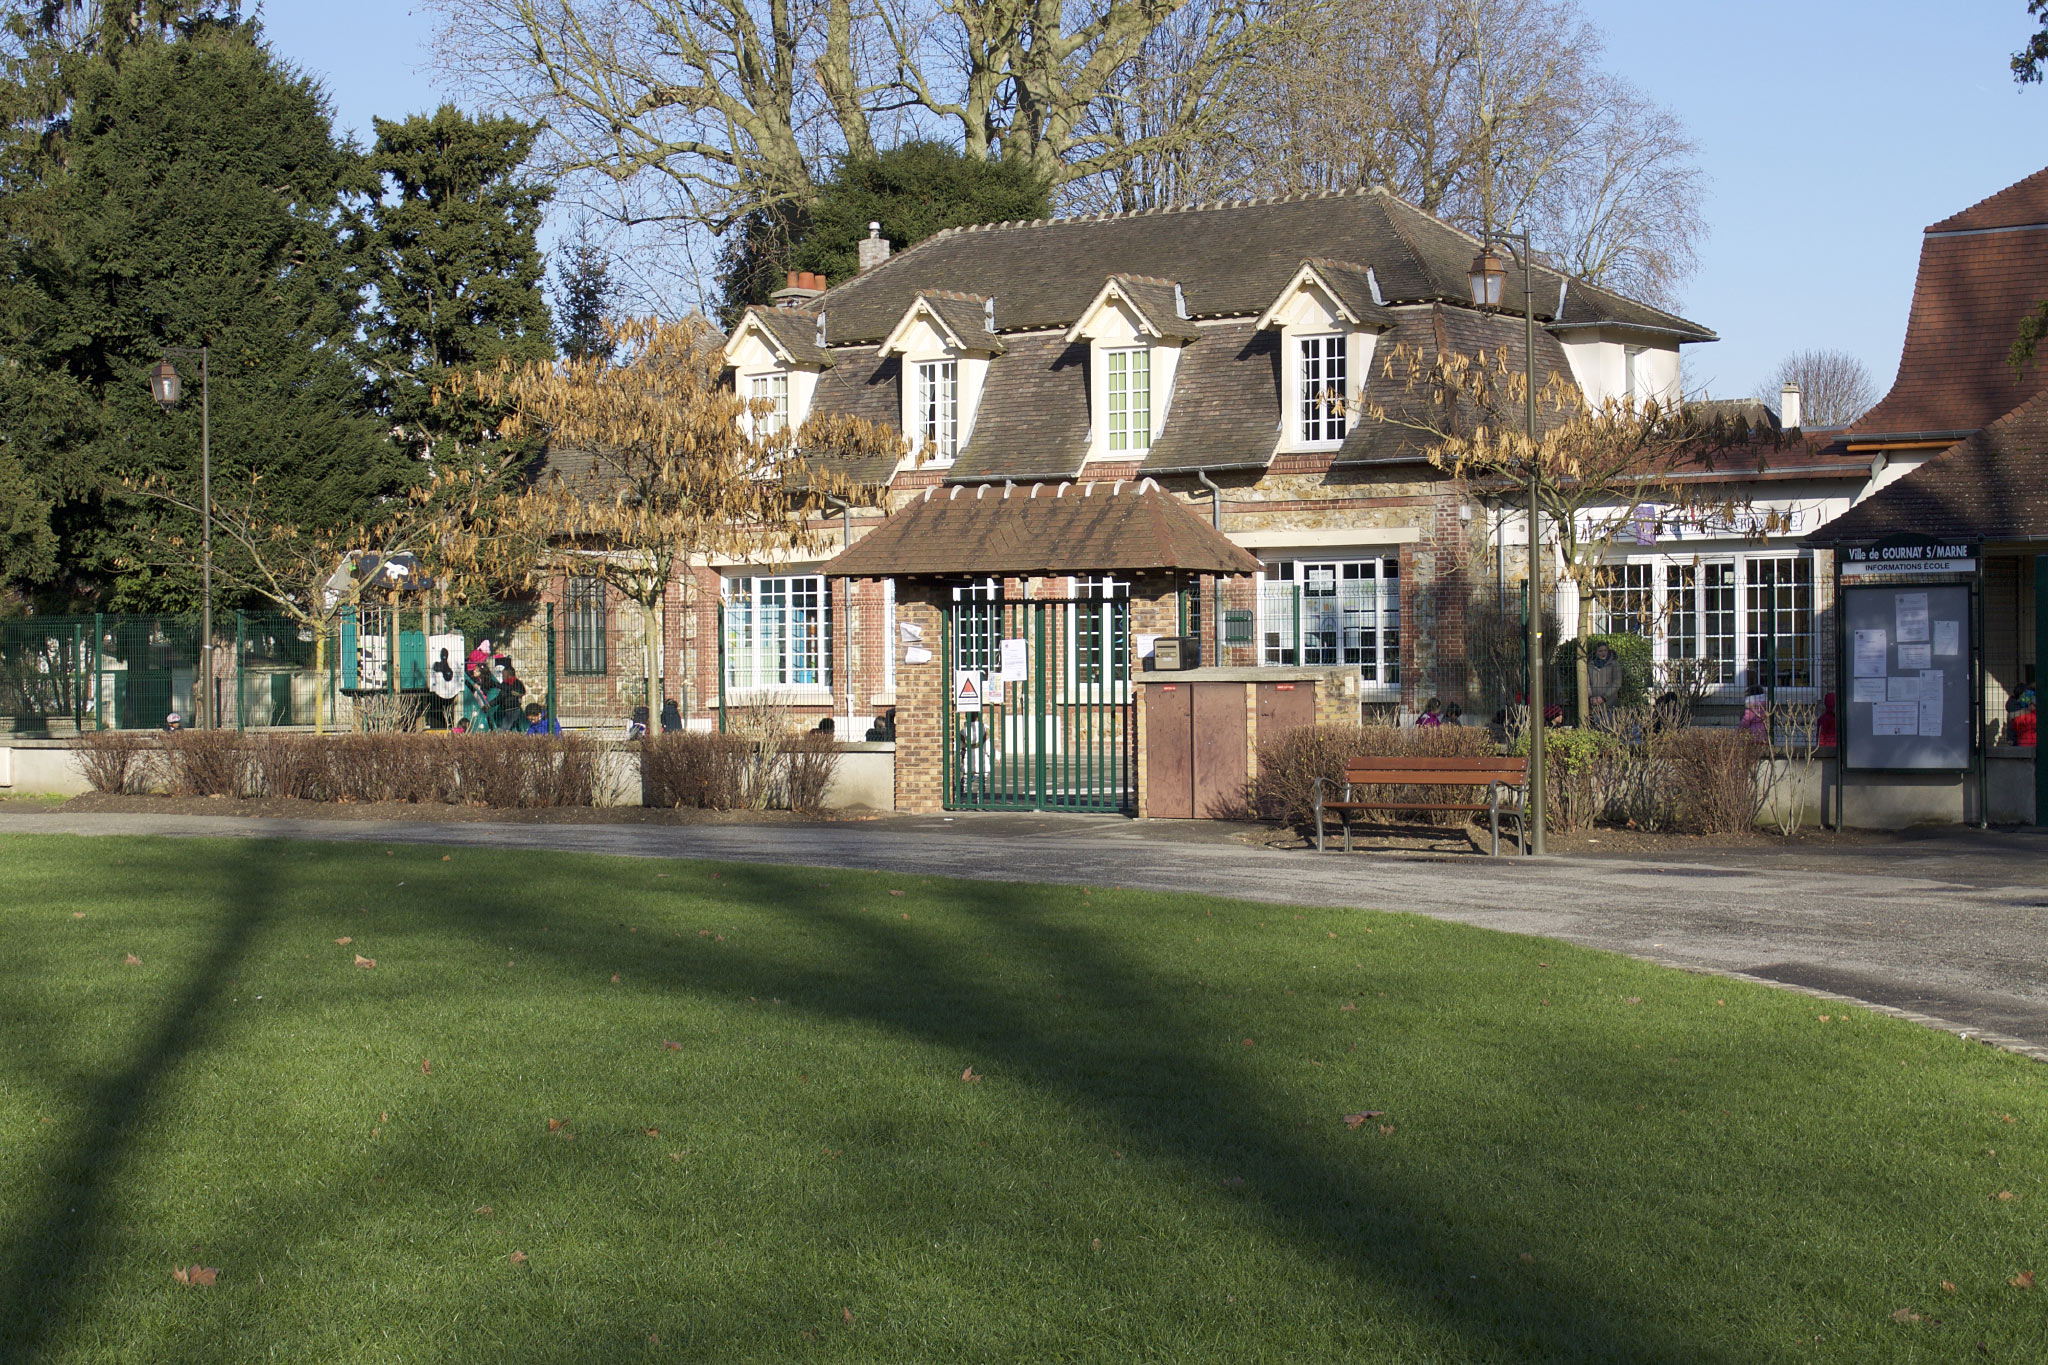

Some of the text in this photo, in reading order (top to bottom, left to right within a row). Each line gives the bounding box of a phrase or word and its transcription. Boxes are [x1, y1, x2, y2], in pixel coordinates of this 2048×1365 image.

[1849, 545, 1967, 560] Ville de GOURNAY S/MARNE
[1865, 561, 1950, 571] INFORMATIONS ÉCOLE
